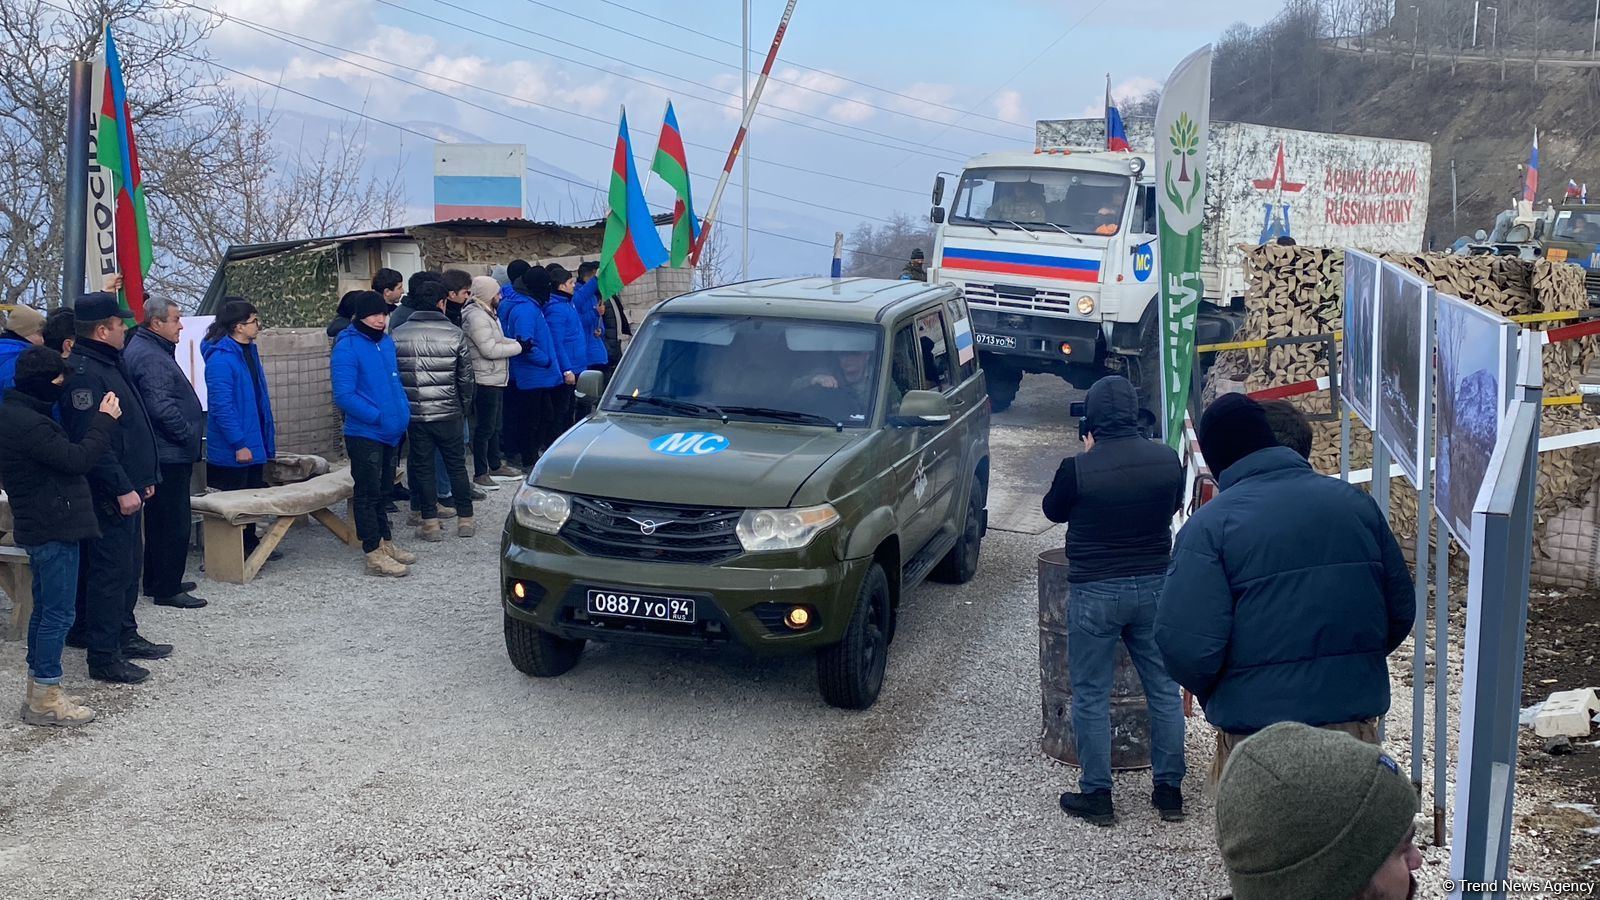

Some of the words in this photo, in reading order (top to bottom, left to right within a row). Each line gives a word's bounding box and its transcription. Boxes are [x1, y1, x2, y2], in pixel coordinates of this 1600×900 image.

[1325, 196, 1376, 225] RUSSIAN
[1378, 199, 1412, 224] ARMY
[976, 334, 995, 345] 0713
[595, 594, 640, 614] 0887
[670, 600, 688, 615] 94
